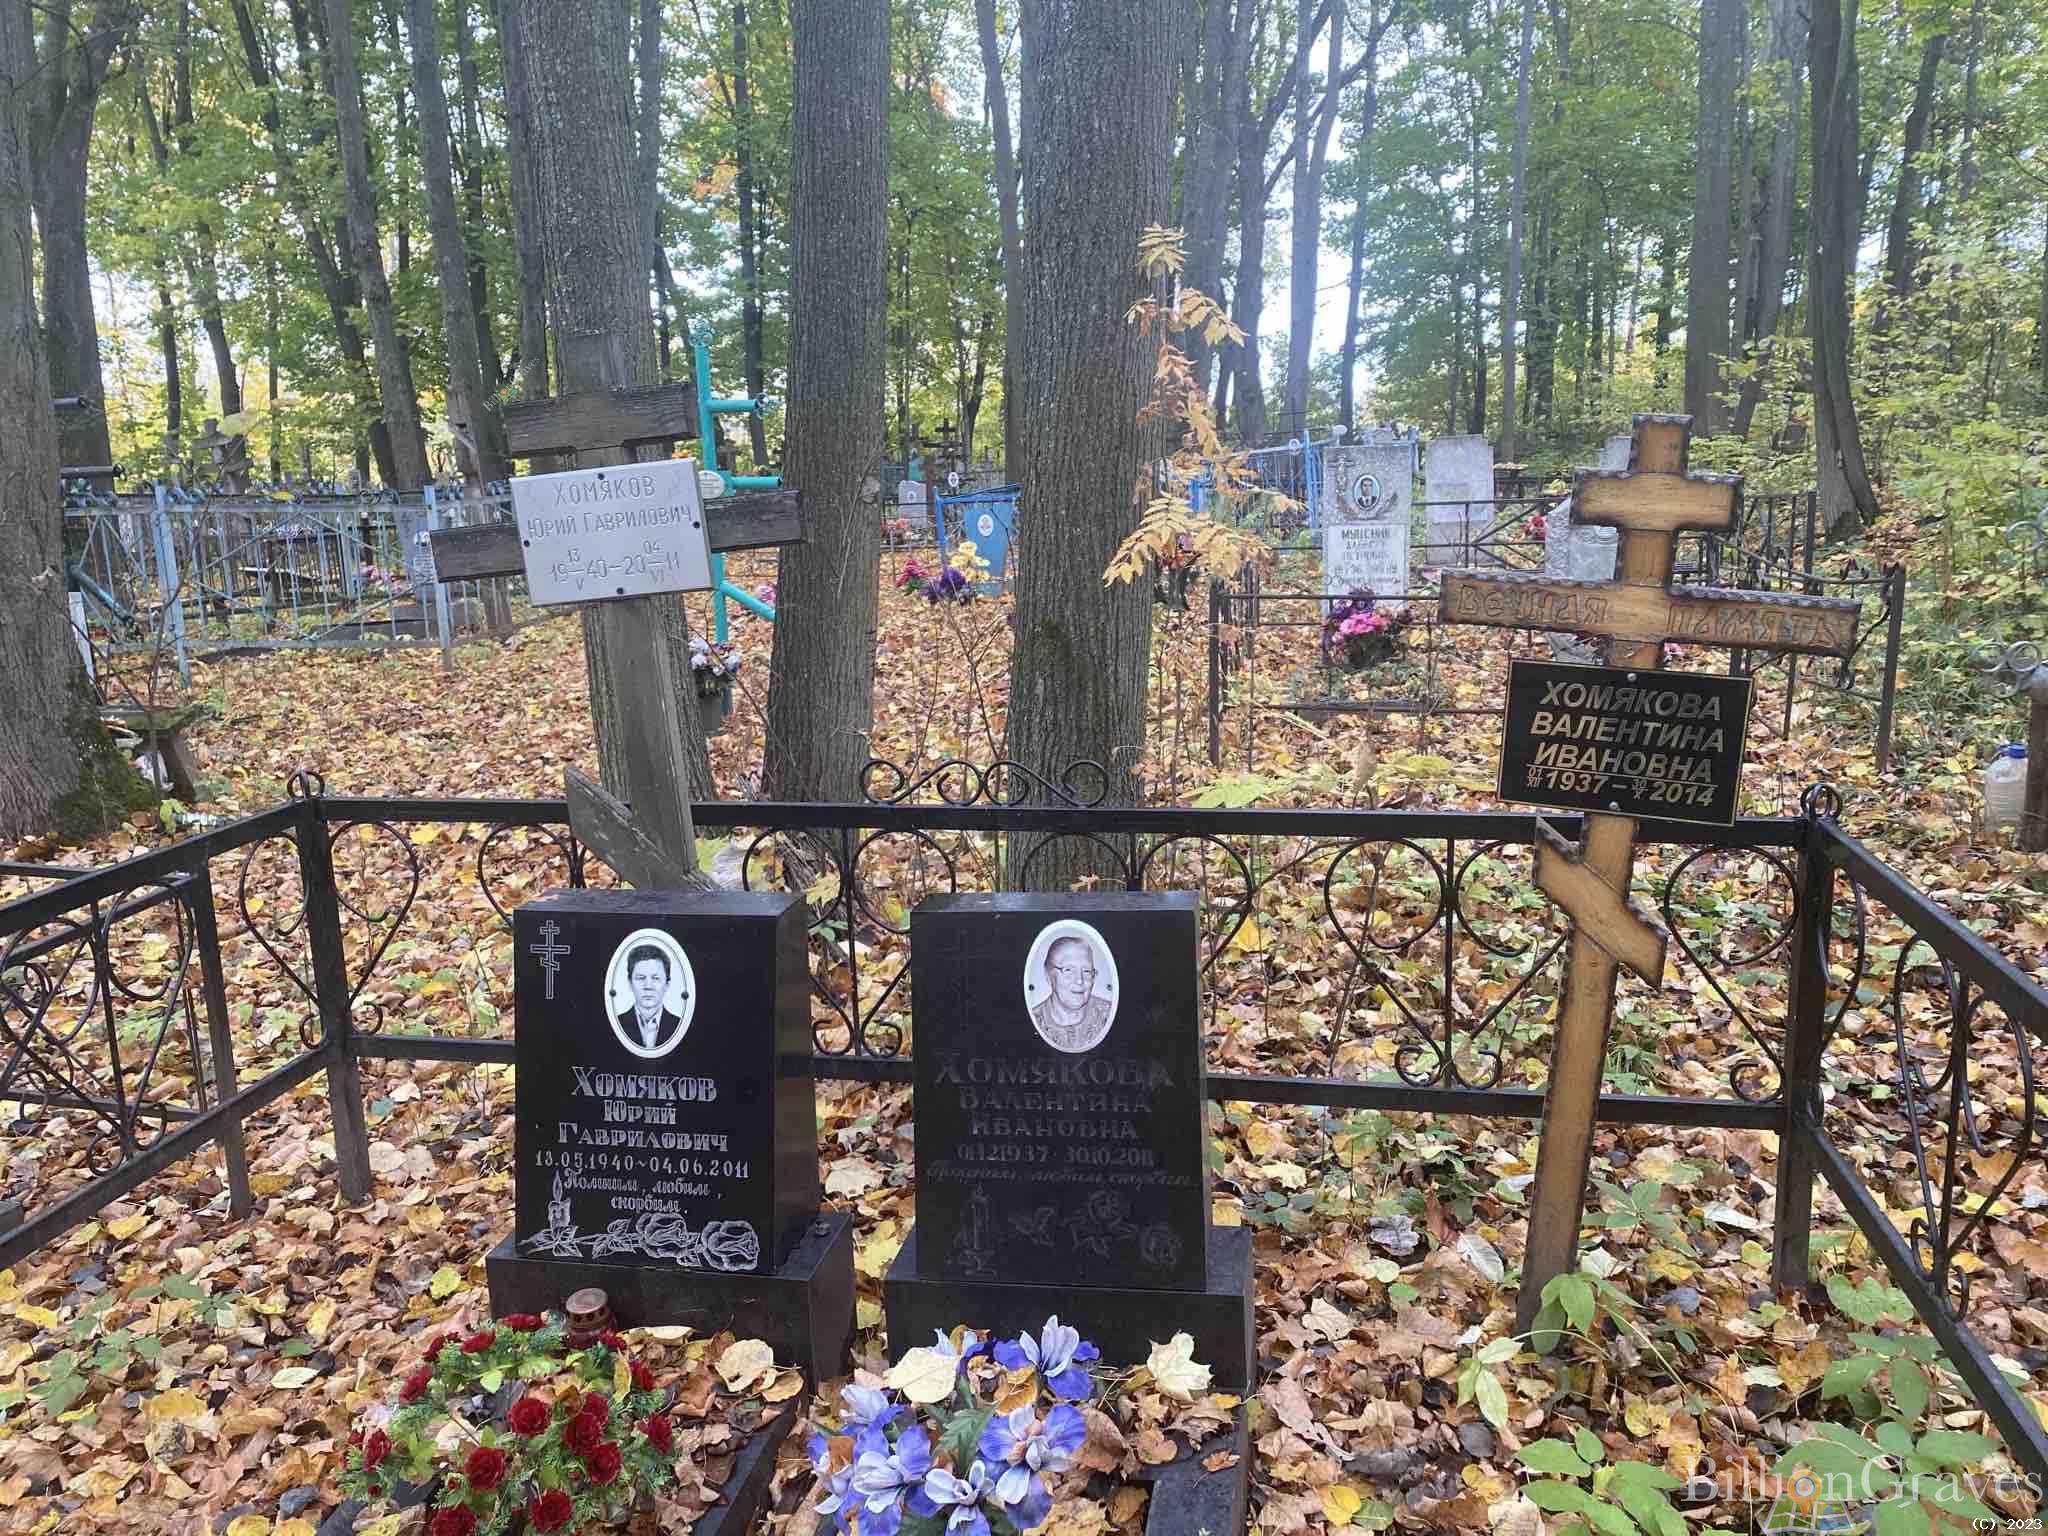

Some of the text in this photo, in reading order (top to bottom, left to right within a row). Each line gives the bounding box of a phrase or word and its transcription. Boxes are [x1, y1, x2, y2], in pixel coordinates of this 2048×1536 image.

[554, 476, 657, 505] ХОМЯКОВ
[527, 504, 693, 539] ЮРИЙ ГАВРИЛОВИЧ
[1541, 681, 1721, 721] ХОМЯКОВА
[1530, 711, 1725, 753] ВАЛЕНТИНА
[1535, 742, 1713, 784] ИВАНОВНА
[1546, 770, 1609, 794] 1937
[1649, 780, 1714, 807] 2014
